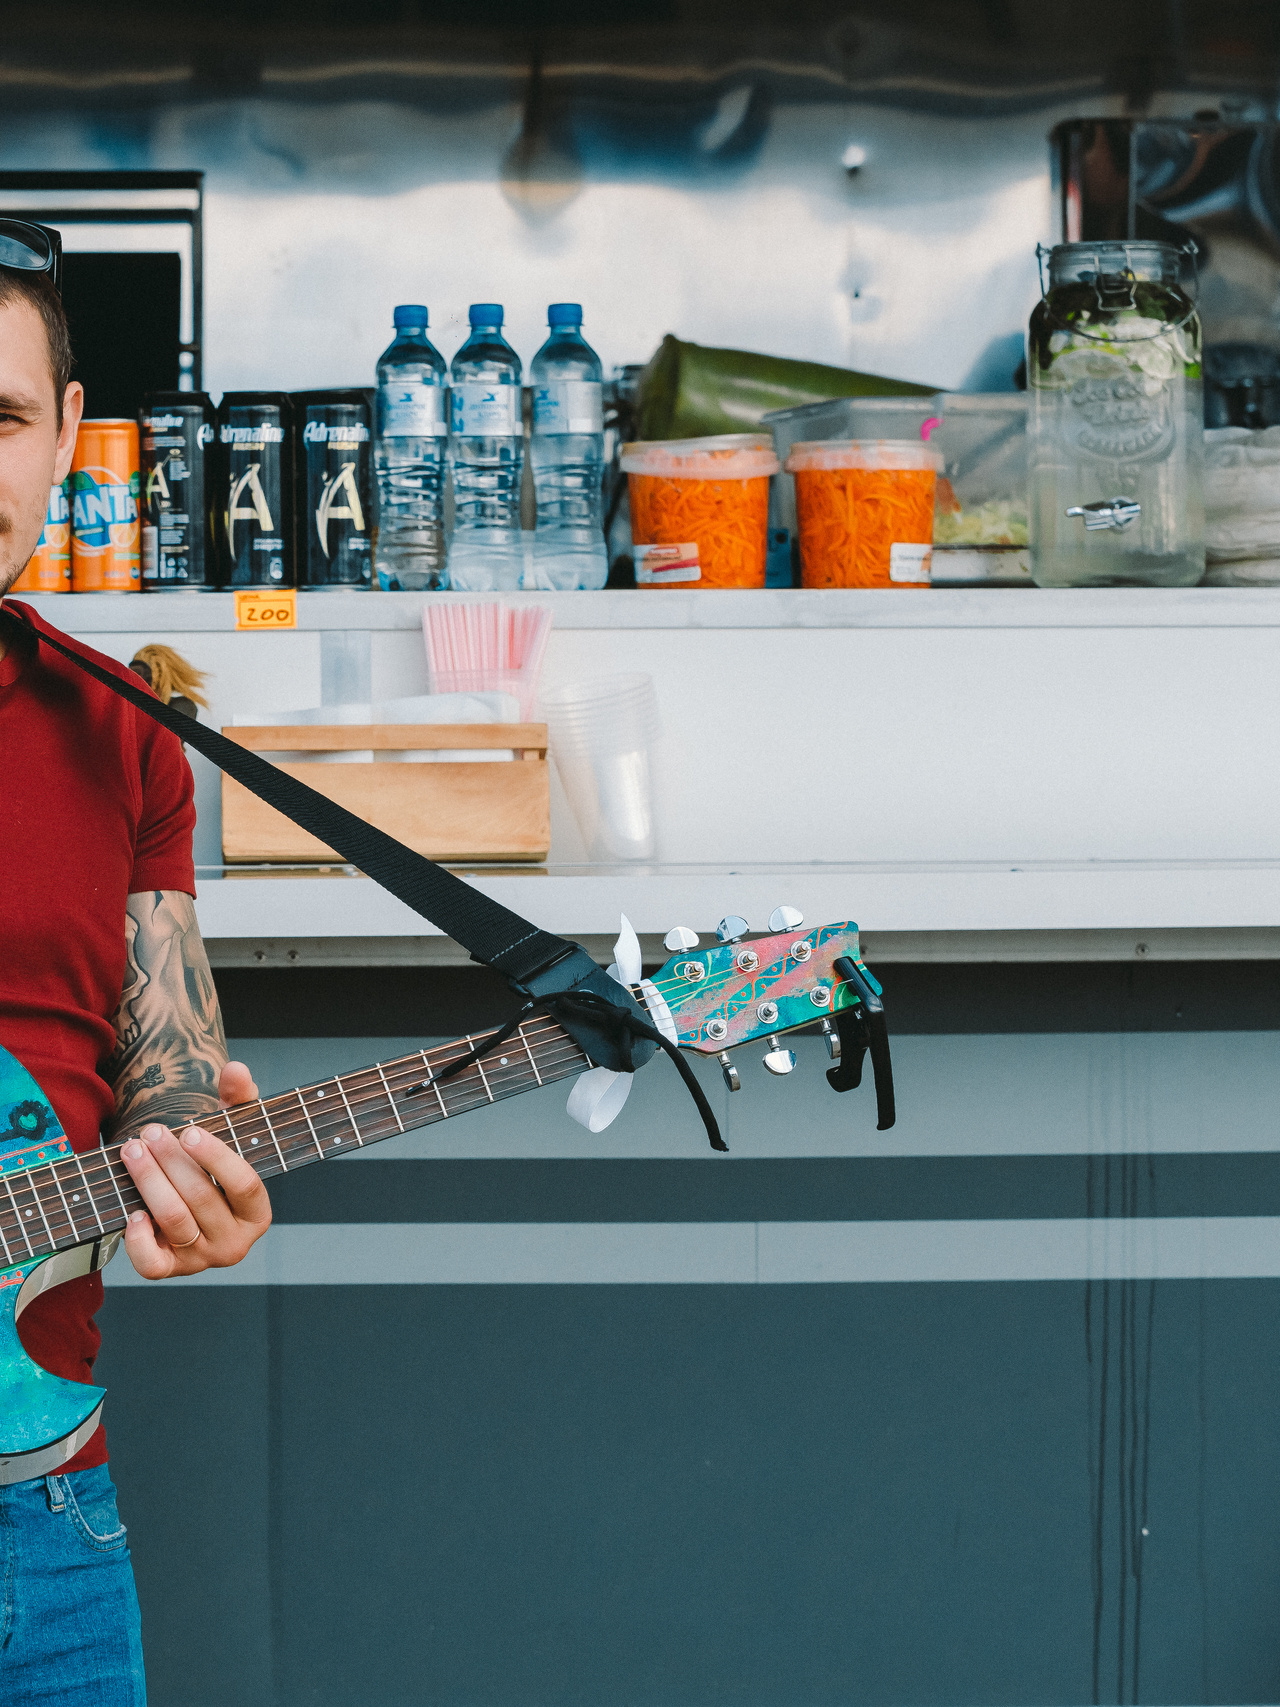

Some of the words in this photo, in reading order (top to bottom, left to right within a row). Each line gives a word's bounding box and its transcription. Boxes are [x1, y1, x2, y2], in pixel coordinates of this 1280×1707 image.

[304, 421, 370, 450] Adrenalin
[74, 486, 138, 527] ANTA
[247, 607, 290, 622] 200
